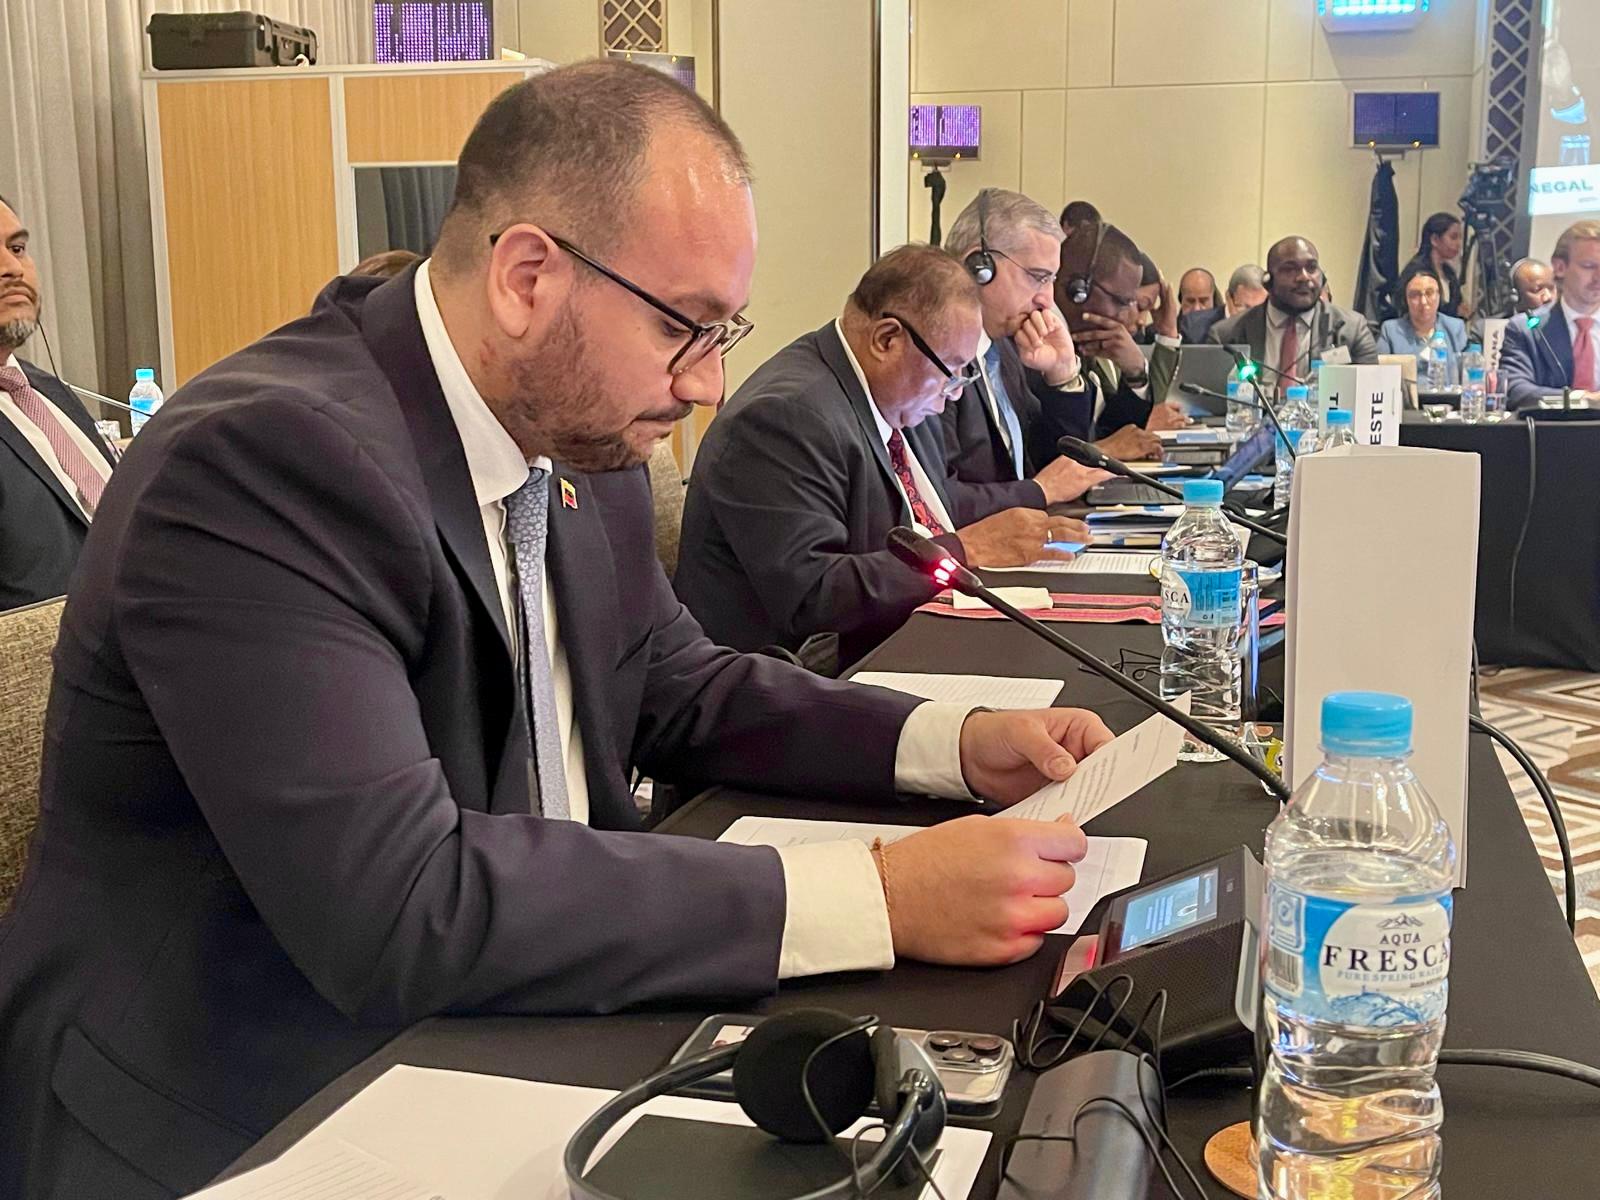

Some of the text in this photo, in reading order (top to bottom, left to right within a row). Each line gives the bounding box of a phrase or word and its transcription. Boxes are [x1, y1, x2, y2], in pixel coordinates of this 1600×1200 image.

[1370, 392, 1384, 446] ESTE
[1379, 933, 1421, 946] AQUA
[1337, 970, 1370, 982] PURE
[1372, 973, 1416, 983] SPRING
